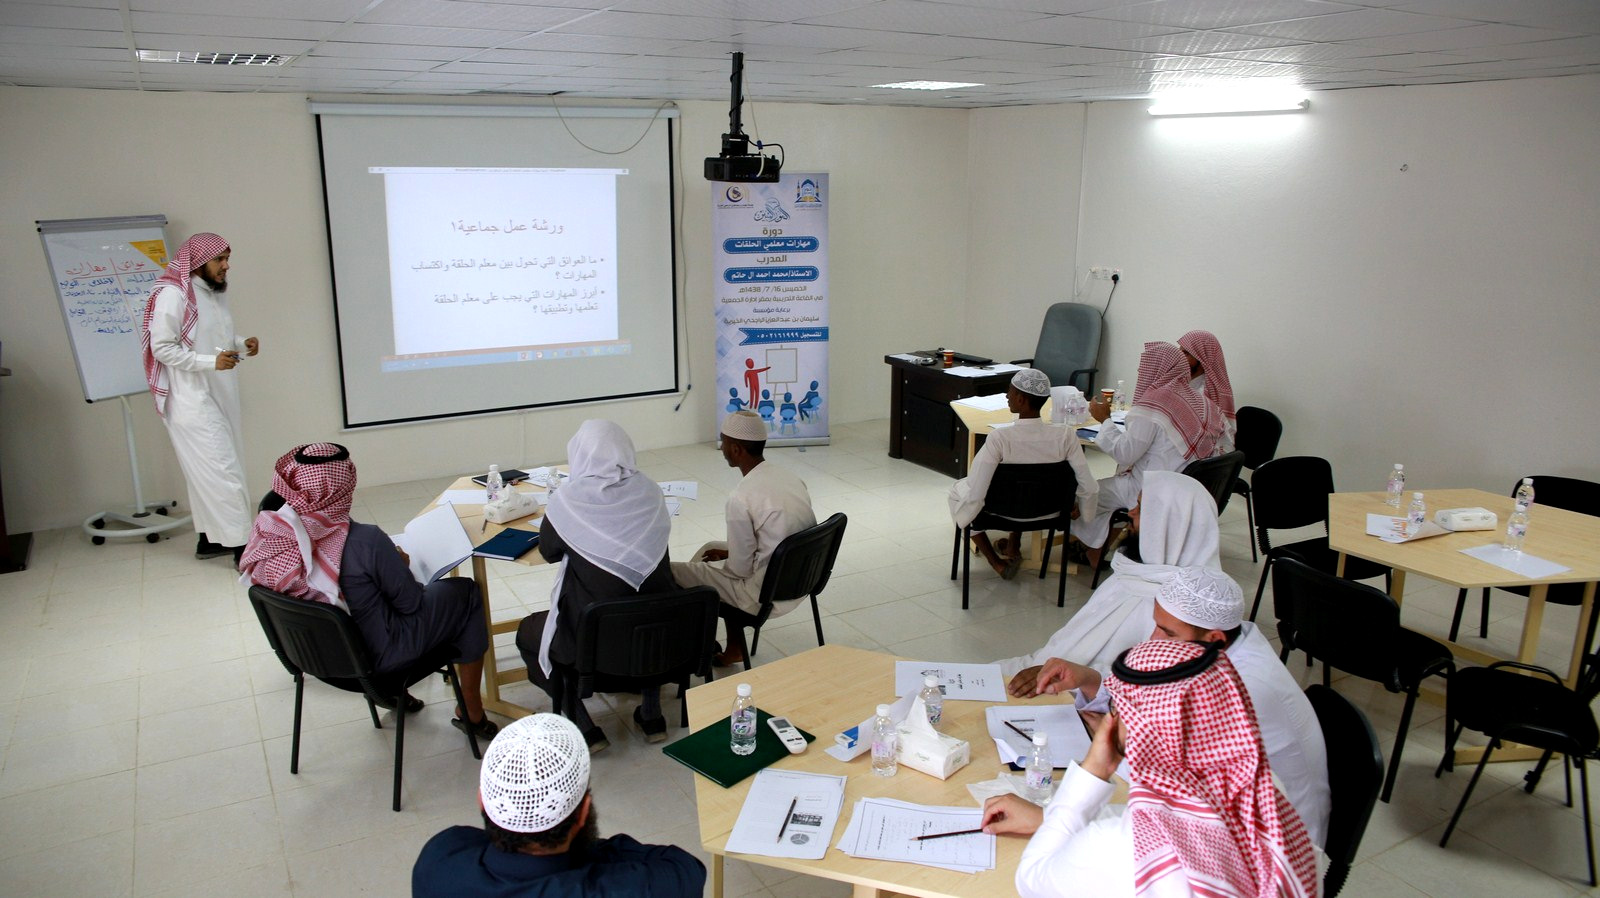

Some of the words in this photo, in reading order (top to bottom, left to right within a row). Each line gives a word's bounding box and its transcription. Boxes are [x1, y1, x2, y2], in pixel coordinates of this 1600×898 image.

[503, 219, 528, 234] عمل
[532, 218, 564, 234] ورشة
[762, 228, 783, 237] دورة
[734, 240, 762, 248] الحلقات
[763, 241, 785, 251] معلمي
[786, 240, 811, 248] مهارات
[451, 258, 476, 269] الحلقة
[479, 258, 497, 271] معلم
[499, 259, 514, 269] بين
[515, 257, 538, 269] تحول
[540, 255, 556, 269] التي
[558, 255, 586, 268] العوائق
[588, 256, 598, 264] ما
[756, 255, 788, 264] المدرب
[411, 260, 450, 272] واكتساب
[562, 269, 598, 281] المهارات
[543, 288, 577, 301] المهارات
[782, 285, 807, 293] الخميس
[434, 293, 458, 304] الحلقة
[462, 293, 480, 306] معلم
[482, 292, 499, 305] على
[503, 294, 522, 303] يجب
[524, 290, 540, 303] التي
[540, 303, 573, 315] وتطبيقها
[575, 302, 599, 314] تعلمها
